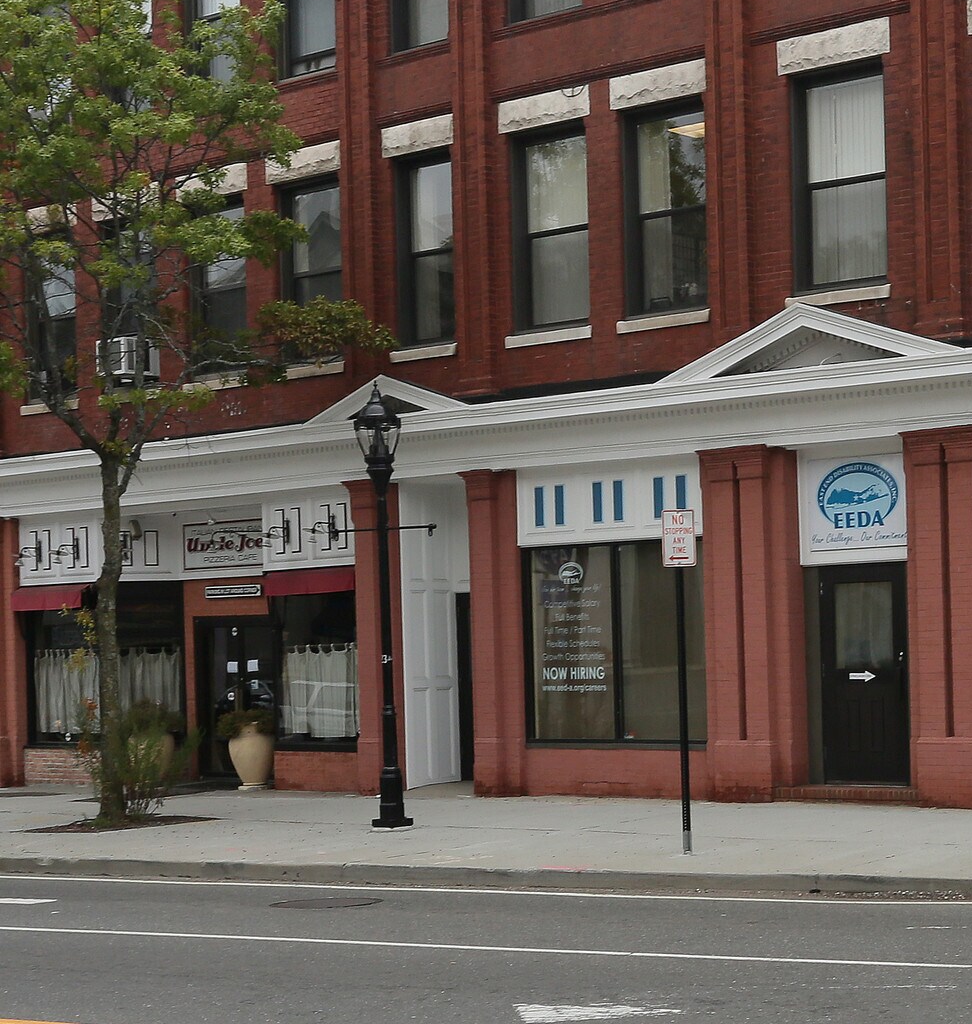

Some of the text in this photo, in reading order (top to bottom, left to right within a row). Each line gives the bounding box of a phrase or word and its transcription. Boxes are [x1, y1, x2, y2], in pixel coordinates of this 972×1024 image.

[671, 515, 684, 525] NO
[833, 509, 884, 529] EEDA
[664, 527, 693, 535] STOPPING
[203, 555, 236, 564] PIZZERIA
[544, 599, 600, 608] Competitive Salary
[565, 652, 605, 661] Opportunities
[542, 666, 605, 680] NOW HIRING
